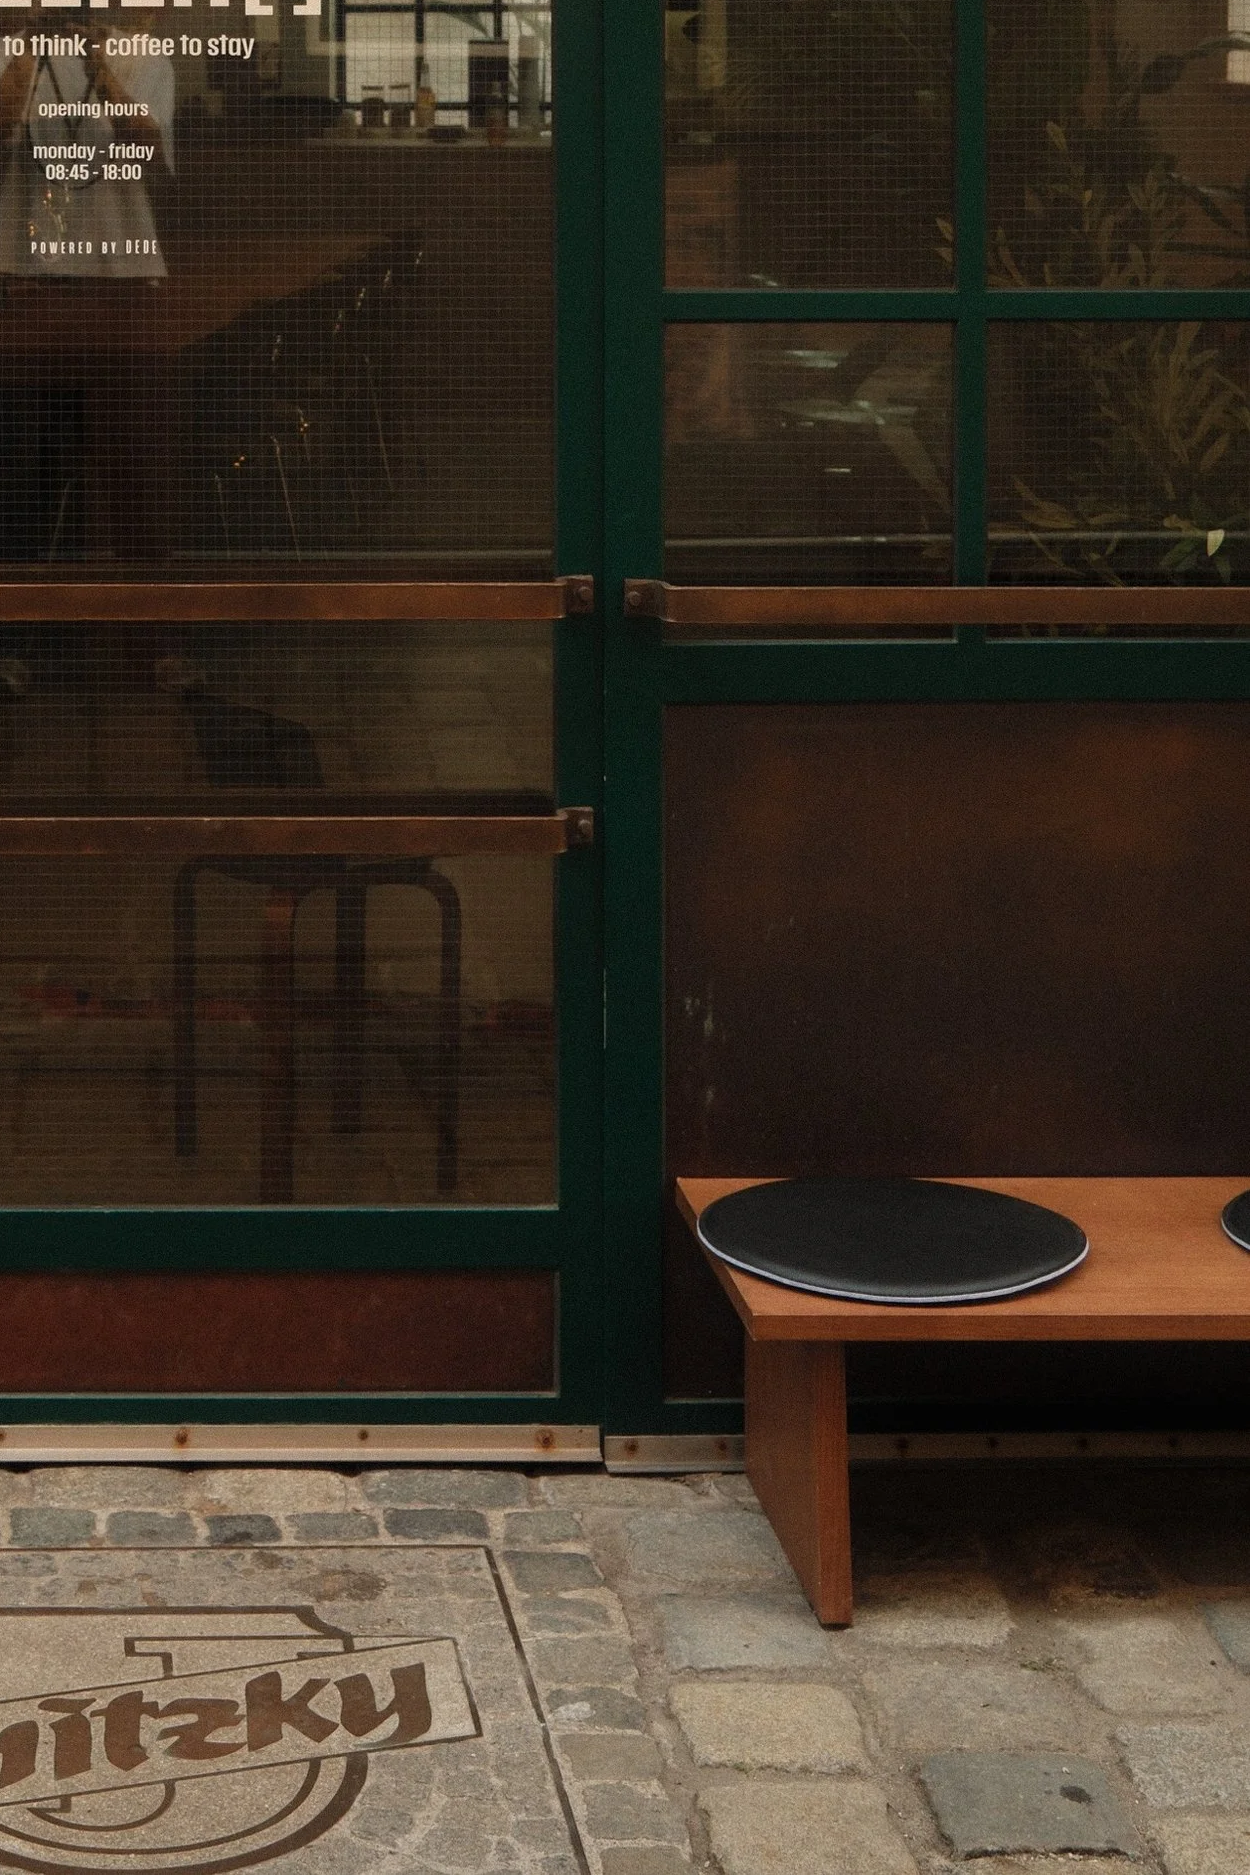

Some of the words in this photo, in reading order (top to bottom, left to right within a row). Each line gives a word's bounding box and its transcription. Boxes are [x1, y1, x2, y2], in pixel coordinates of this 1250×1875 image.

[2, 35, 25, 57] to
[29, 33, 88, 57] think
[104, 33, 175, 57] coffee
[179, 34, 202, 57] to
[207, 34, 255, 60] stay
[38, 100, 101, 118] opening
[104, 100, 149, 117] hours
[33, 142, 96, 161] monday
[108, 142, 155, 162] friday
[45, 163, 91, 181] 08:45
[101, 163, 142, 181] 18:00
[31, 241, 93, 254] POWERED
[101, 241, 117, 254] BY
[125, 239, 157, 254] DEDE
